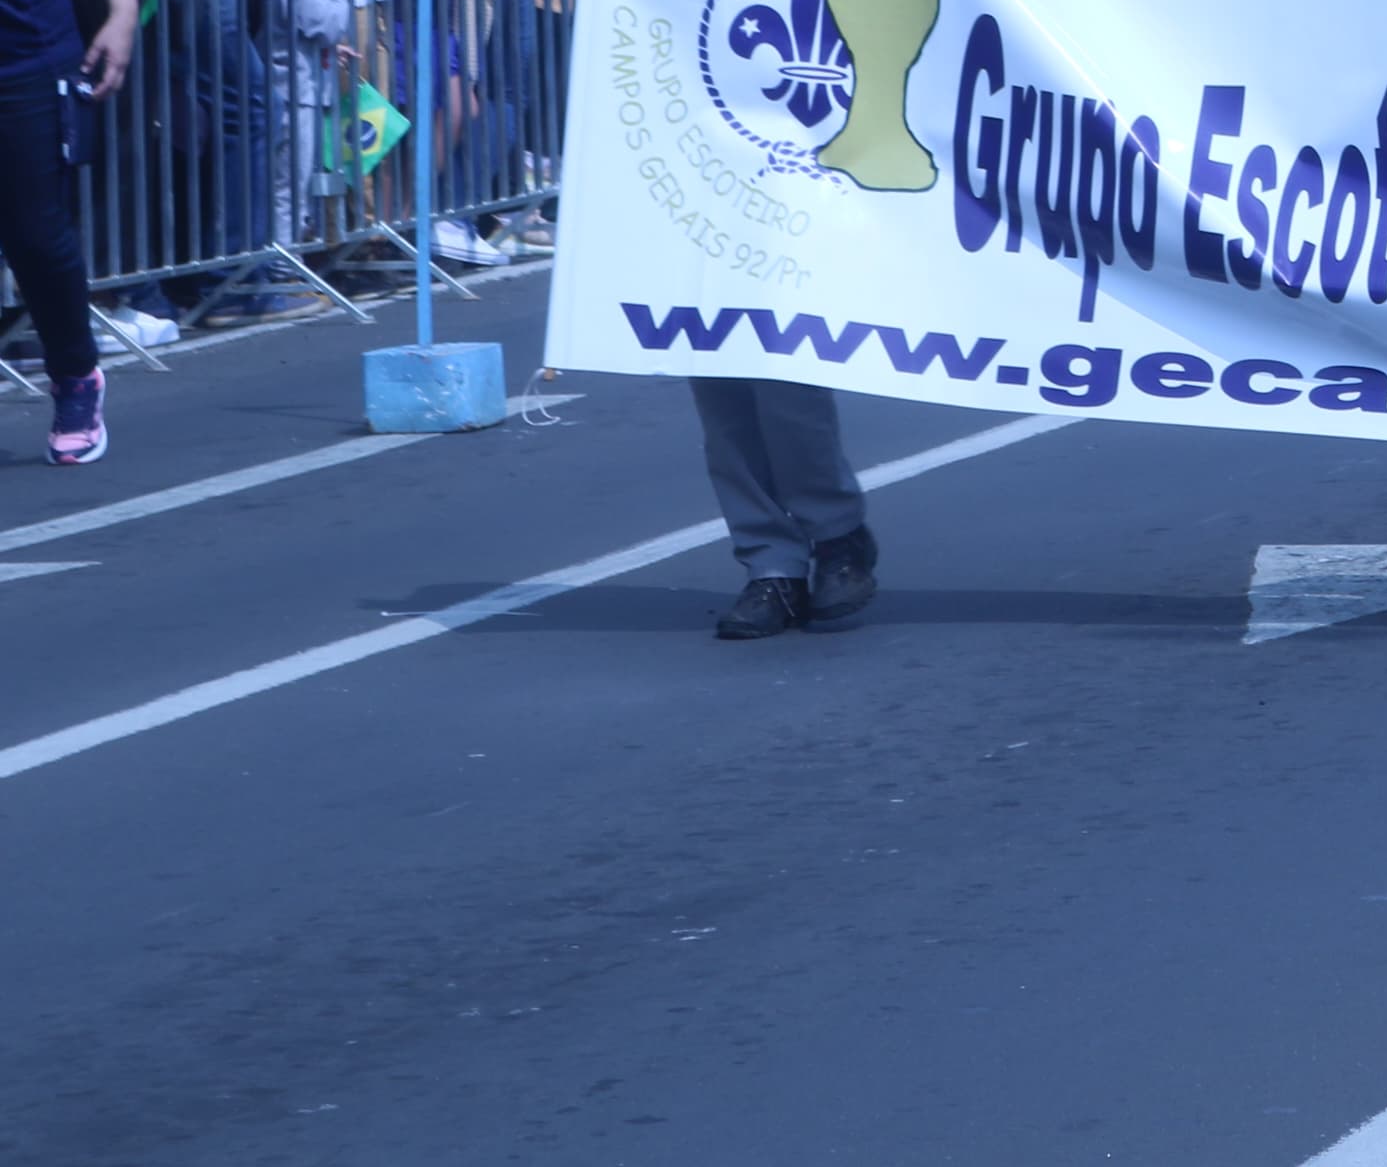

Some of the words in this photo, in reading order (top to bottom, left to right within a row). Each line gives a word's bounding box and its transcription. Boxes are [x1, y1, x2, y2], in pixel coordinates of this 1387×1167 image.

[610, 5, 652, 151] CAMPOS
[638, 156, 731, 259] GERAIS
[648, 18, 689, 124] GRUPO
[677, 123, 811, 238] ESCOTEIRO
[953, 14, 1161, 323] Grupo
